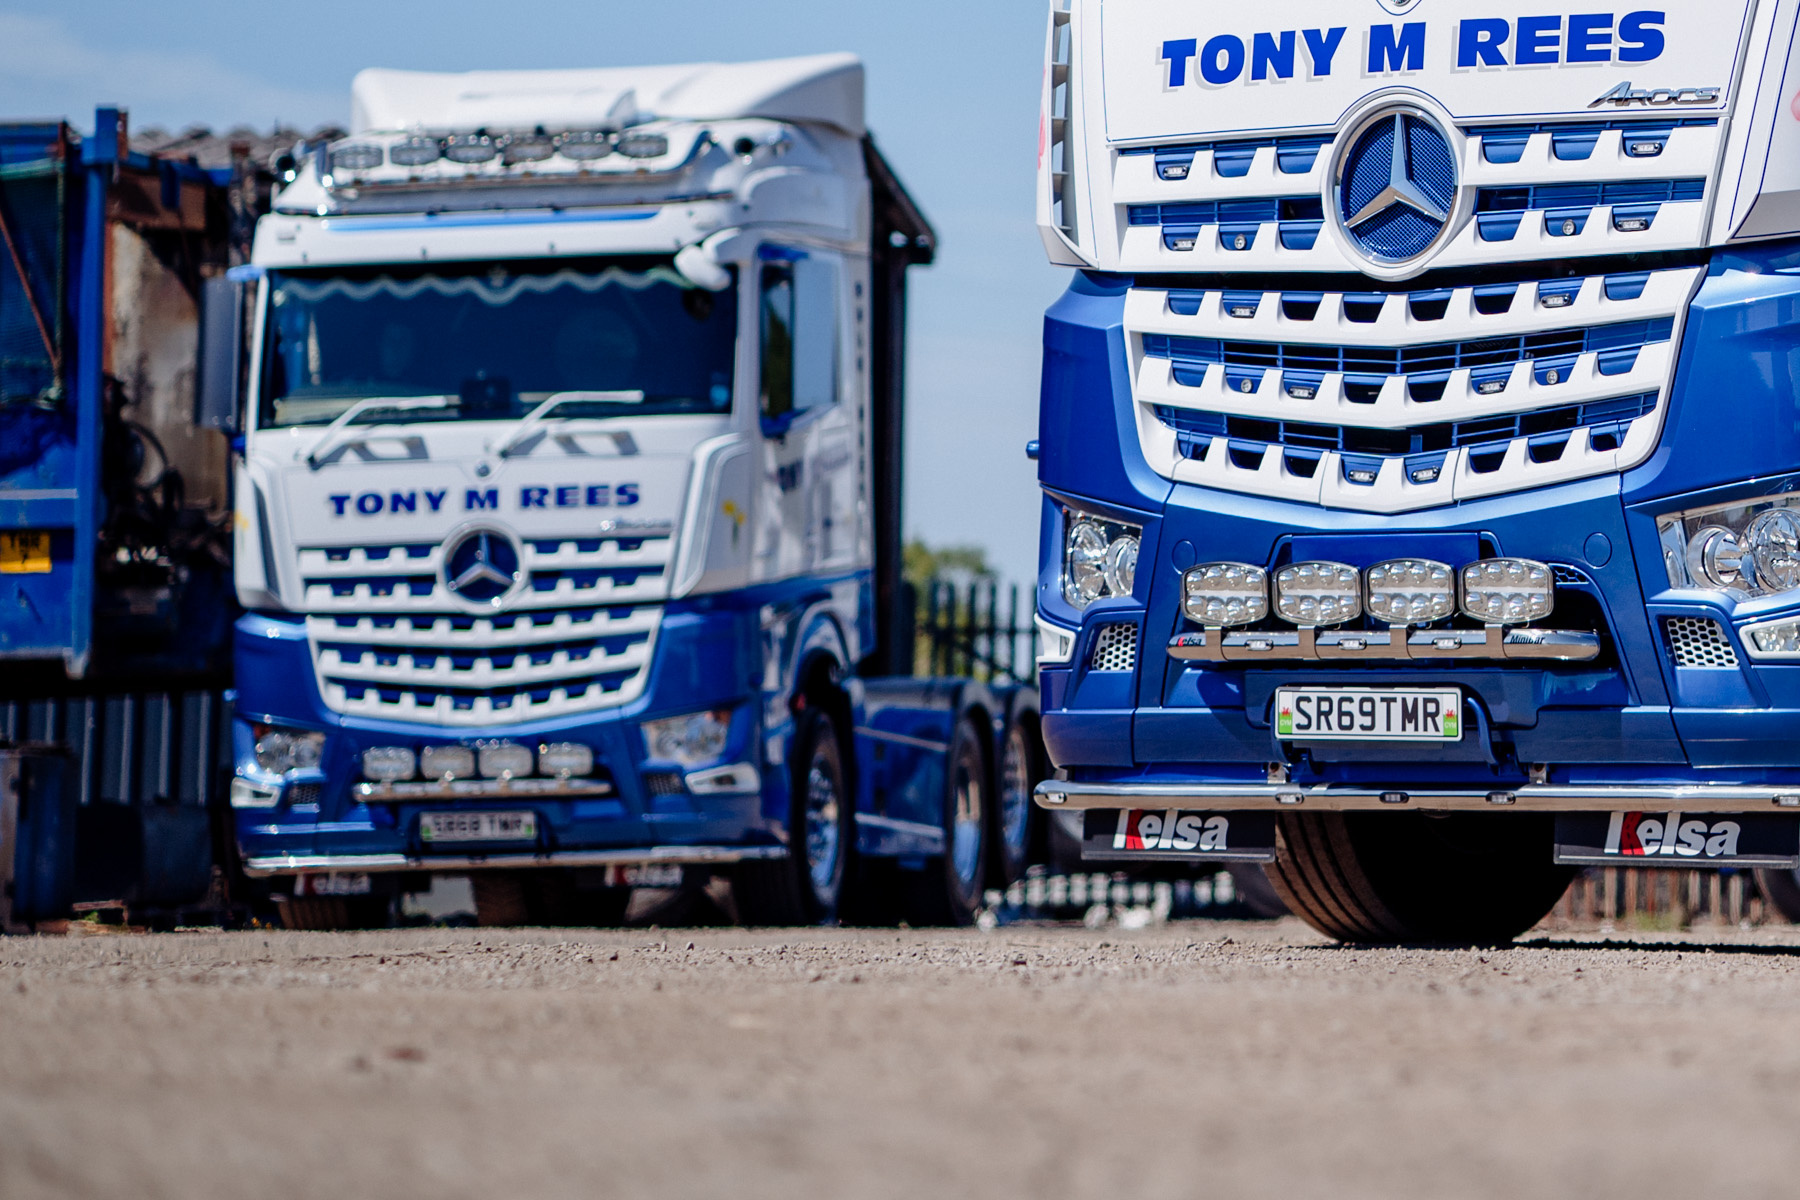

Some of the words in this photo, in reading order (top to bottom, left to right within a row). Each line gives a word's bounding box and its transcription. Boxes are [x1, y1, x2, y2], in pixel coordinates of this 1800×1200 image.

[1160, 26, 1347, 88] TONY
[1367, 21, 1426, 73] M
[1456, 9, 1666, 68] REES
[328, 490, 447, 515] TONY
[464, 489, 499, 511] M
[520, 483, 640, 509] REES
[1294, 695, 1441, 733] SR69TMR
[1112, 808, 1229, 851] Kelsa
[1603, 810, 1741, 858] Kelsa
